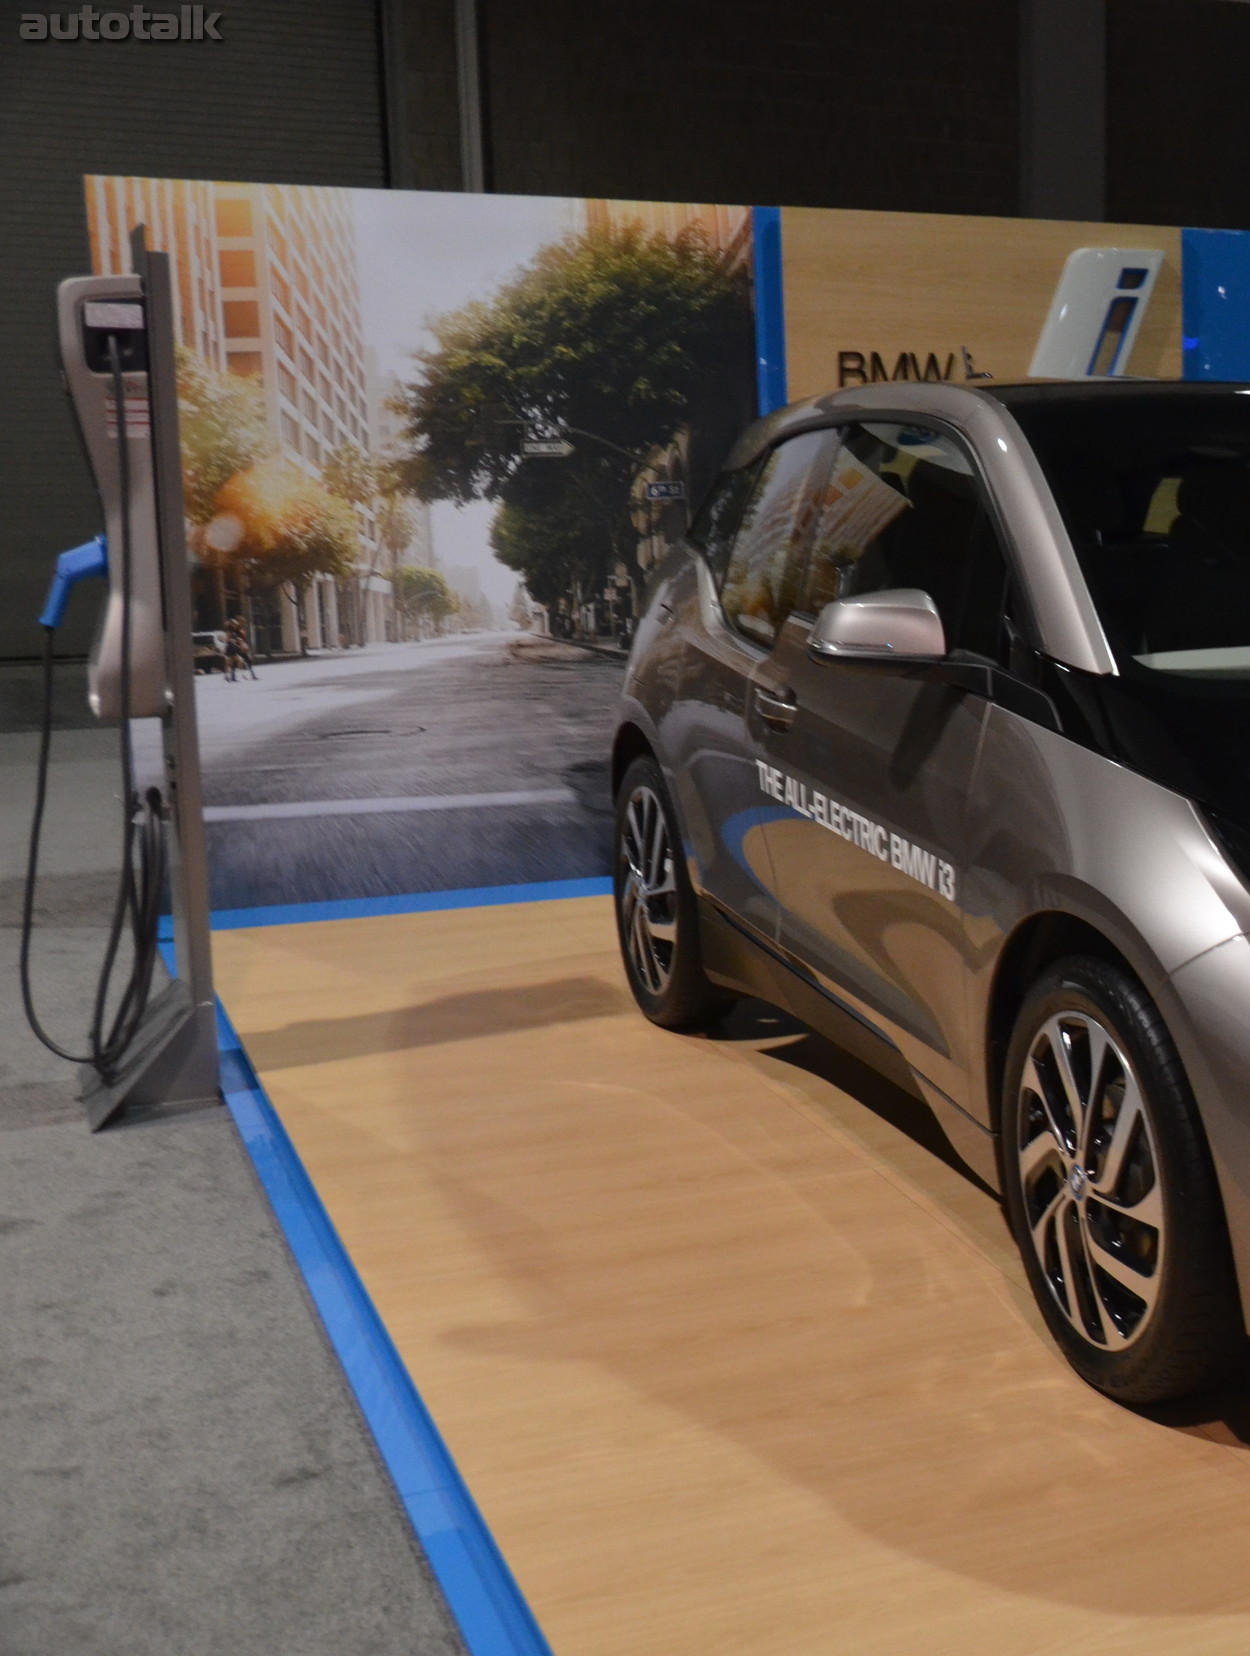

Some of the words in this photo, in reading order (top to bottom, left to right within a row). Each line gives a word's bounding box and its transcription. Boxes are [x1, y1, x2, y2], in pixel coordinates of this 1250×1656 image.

[838, 352, 954, 387] BMW
[756, 758, 785, 803] THE
[785, 775, 888, 862] ALL-ELECTRIC
[890, 833, 937, 889] BMW
[938, 859, 956, 901] i3
